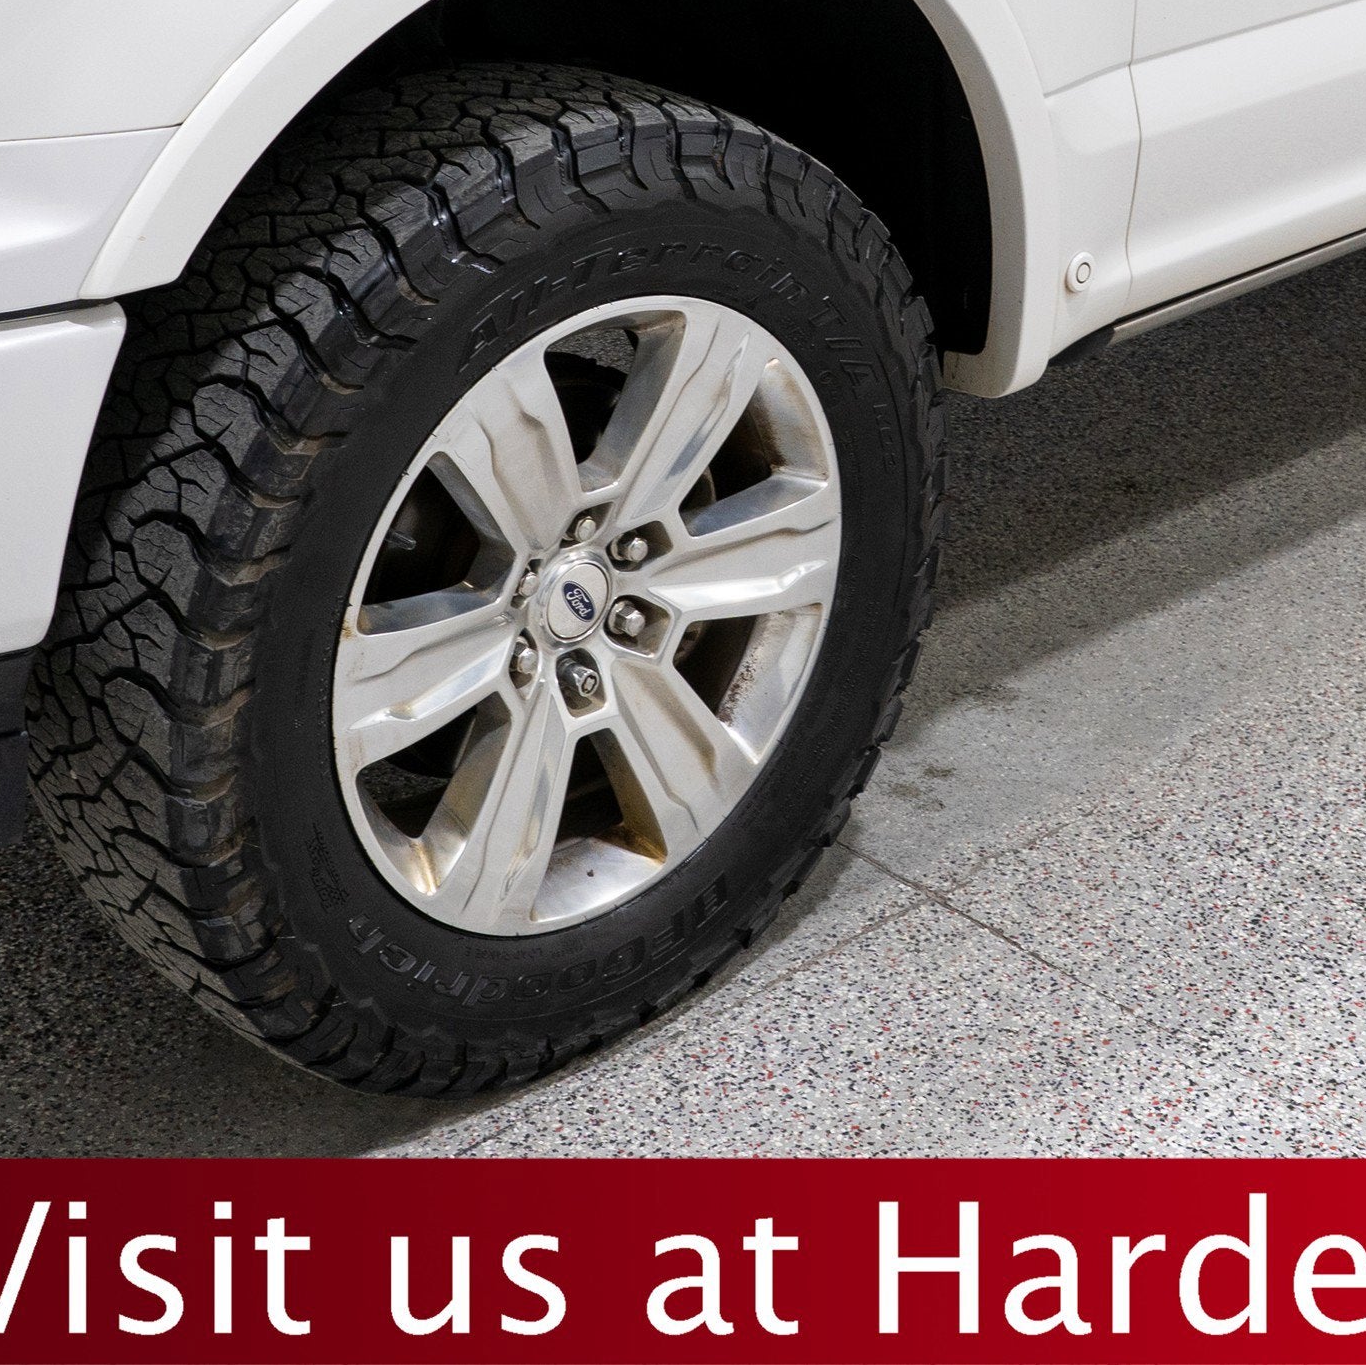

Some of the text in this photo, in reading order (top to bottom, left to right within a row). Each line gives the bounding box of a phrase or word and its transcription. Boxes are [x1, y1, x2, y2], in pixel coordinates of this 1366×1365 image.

[457, 240, 811, 374] All-Terrain
[563, 586, 591, 618] Ford
[347, 870, 730, 1008] BFGoodrich
